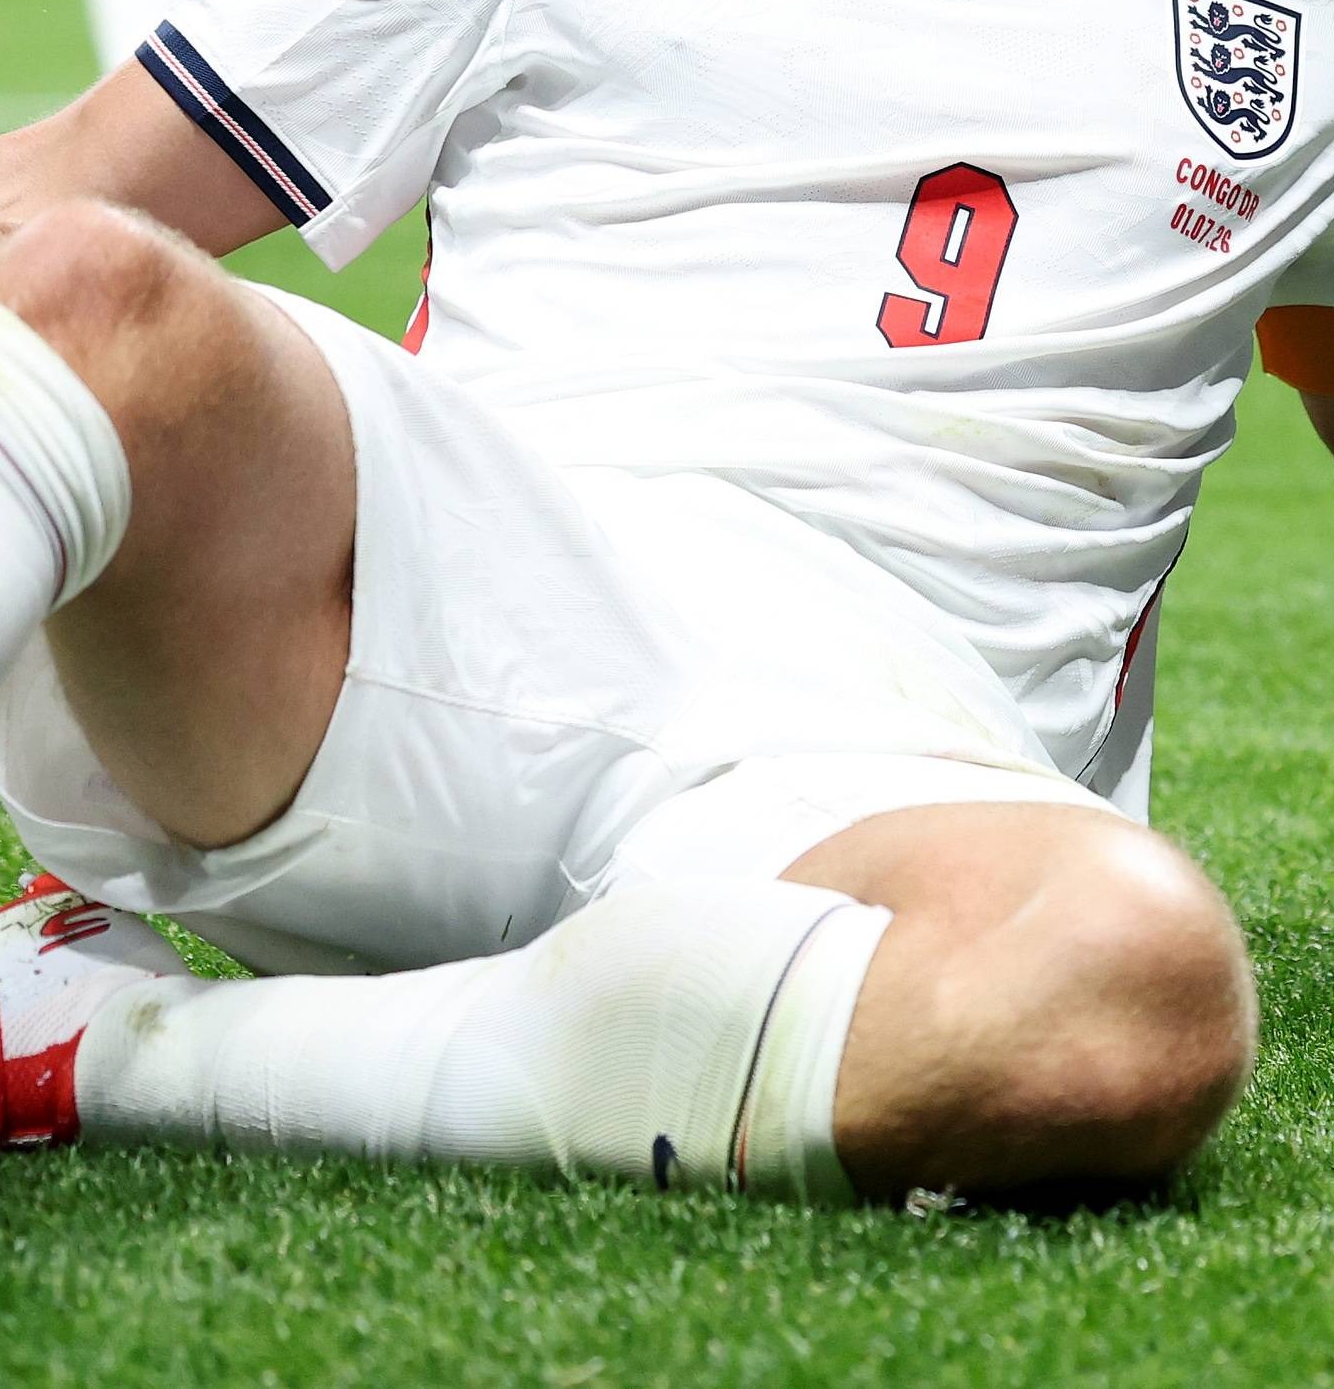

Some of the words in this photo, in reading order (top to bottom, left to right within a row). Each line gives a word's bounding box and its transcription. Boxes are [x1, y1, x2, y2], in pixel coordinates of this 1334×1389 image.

[1176, 157, 1241, 211] CONGO
[1237, 188, 1260, 222] DR
[875, 161, 1019, 349] 9
[1170, 203, 1232, 253] 01.07.26
